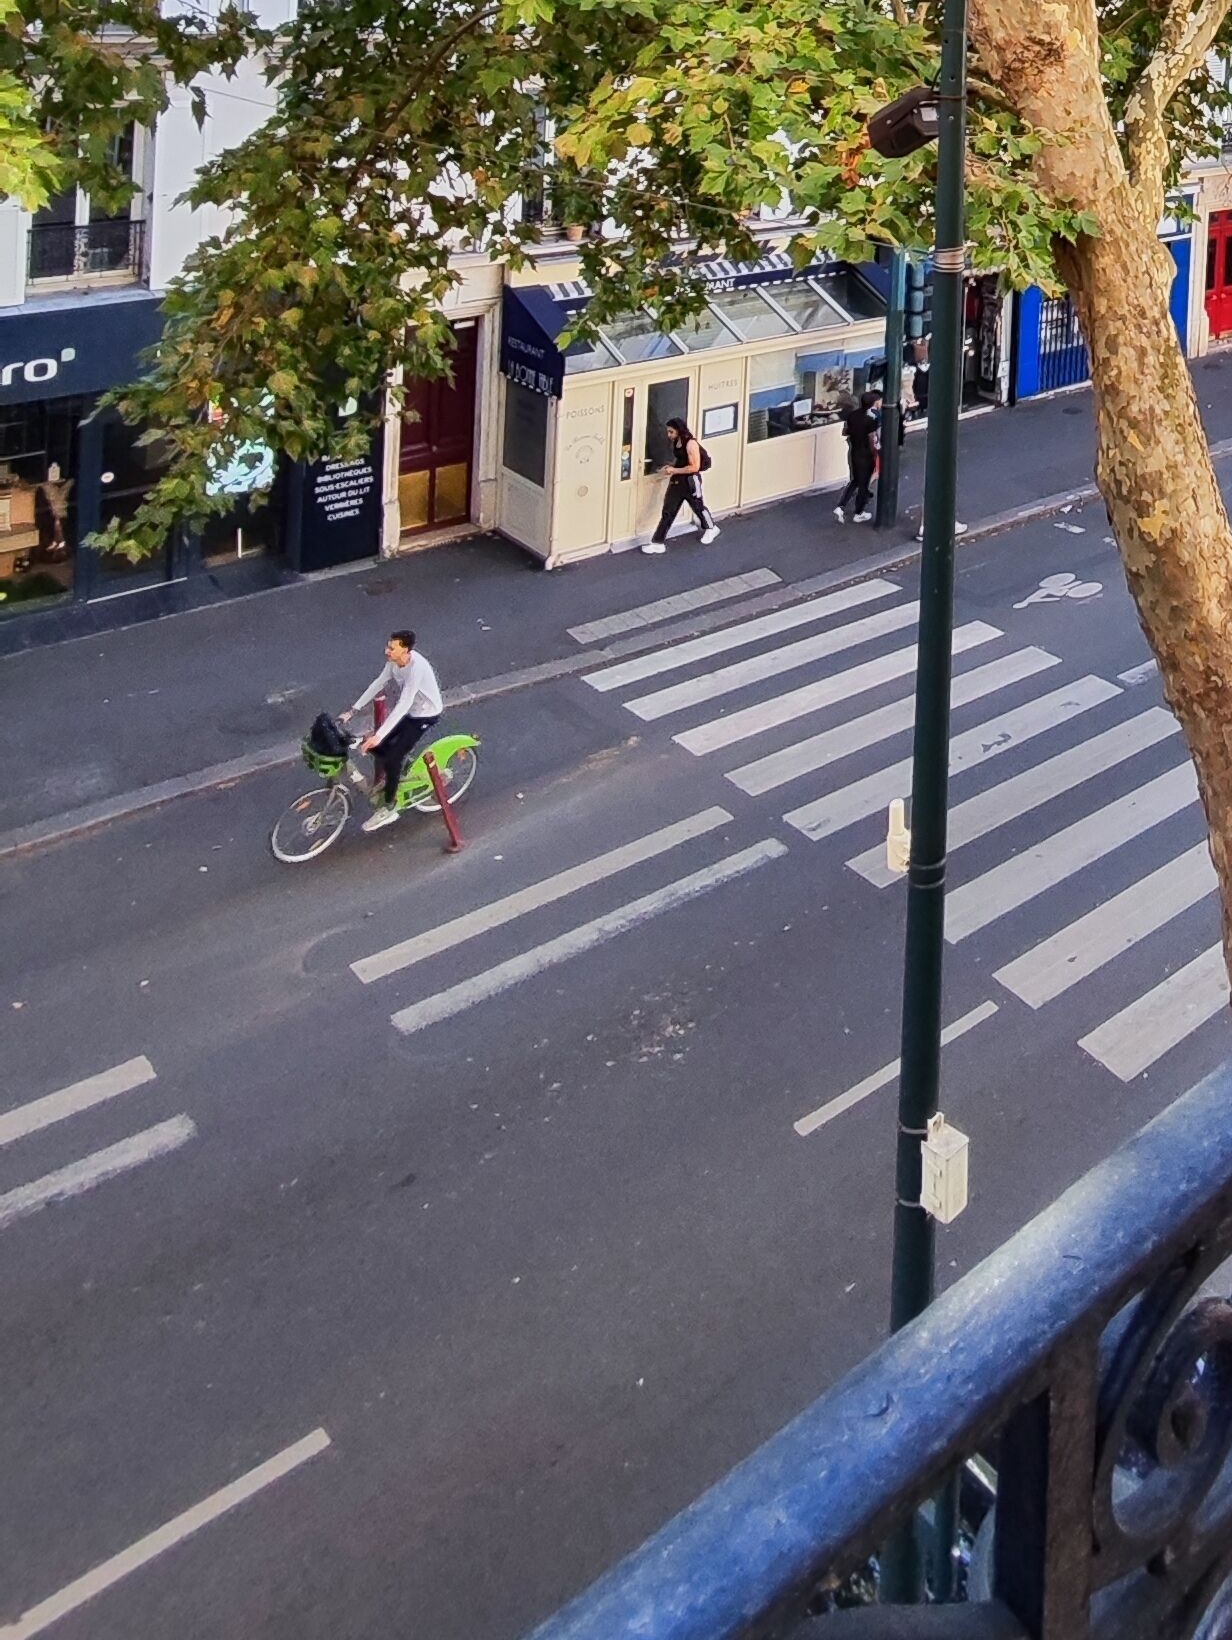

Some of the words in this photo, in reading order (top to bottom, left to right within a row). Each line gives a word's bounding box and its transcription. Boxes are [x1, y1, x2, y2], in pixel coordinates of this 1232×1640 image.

[0, 358, 58, 386] ro
[566, 404, 605, 420] POISSONS
[317, 491, 347, 504] AUTOUR
[348, 488, 359, 497] DU
[359, 486, 371, 495] LIT
